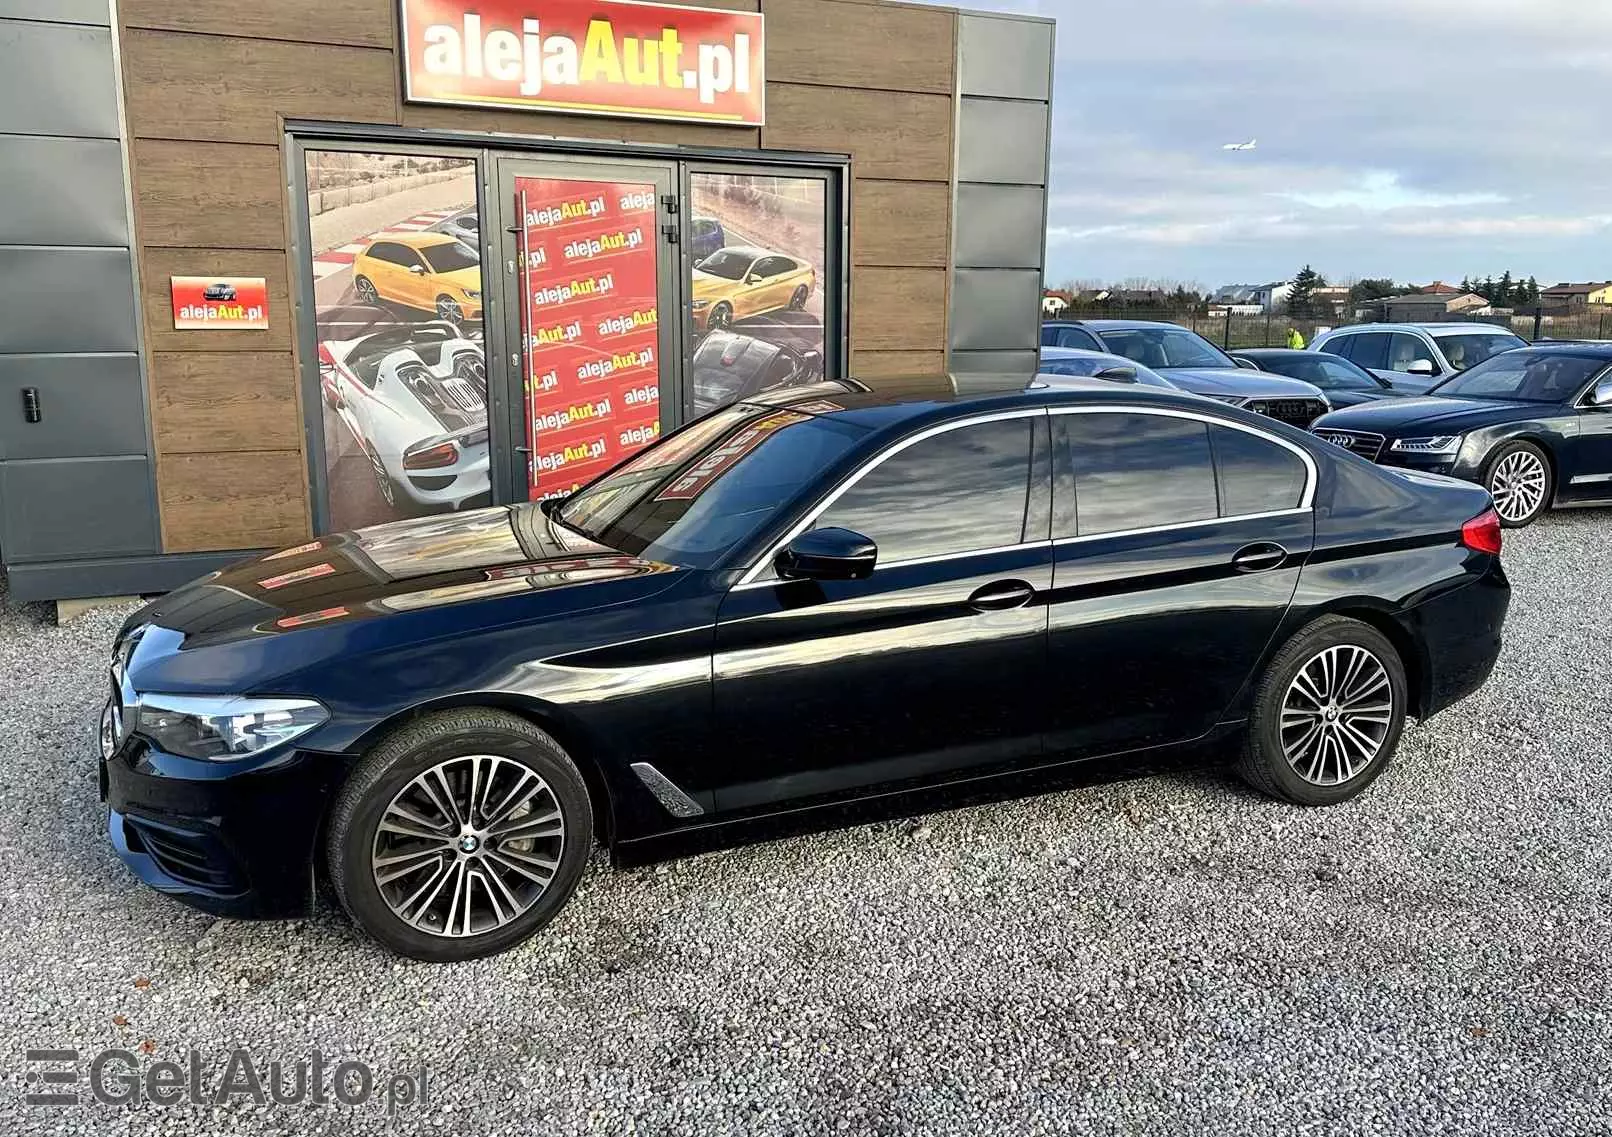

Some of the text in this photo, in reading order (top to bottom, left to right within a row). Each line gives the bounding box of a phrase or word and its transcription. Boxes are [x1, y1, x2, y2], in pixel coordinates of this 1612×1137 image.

[424, 12, 750, 104] alejaAut.pl
[526, 196, 606, 226] alejaAut.pl
[564, 228, 643, 258] alejaAut.pl
[534, 274, 614, 305] alejaAut.pl
[180, 304, 263, 321] alejaAut.pl
[577, 347, 653, 379] alejaAut.pl
[536, 399, 611, 431] alejaAut.pl
[529, 438, 606, 473] alejaAut.pl
